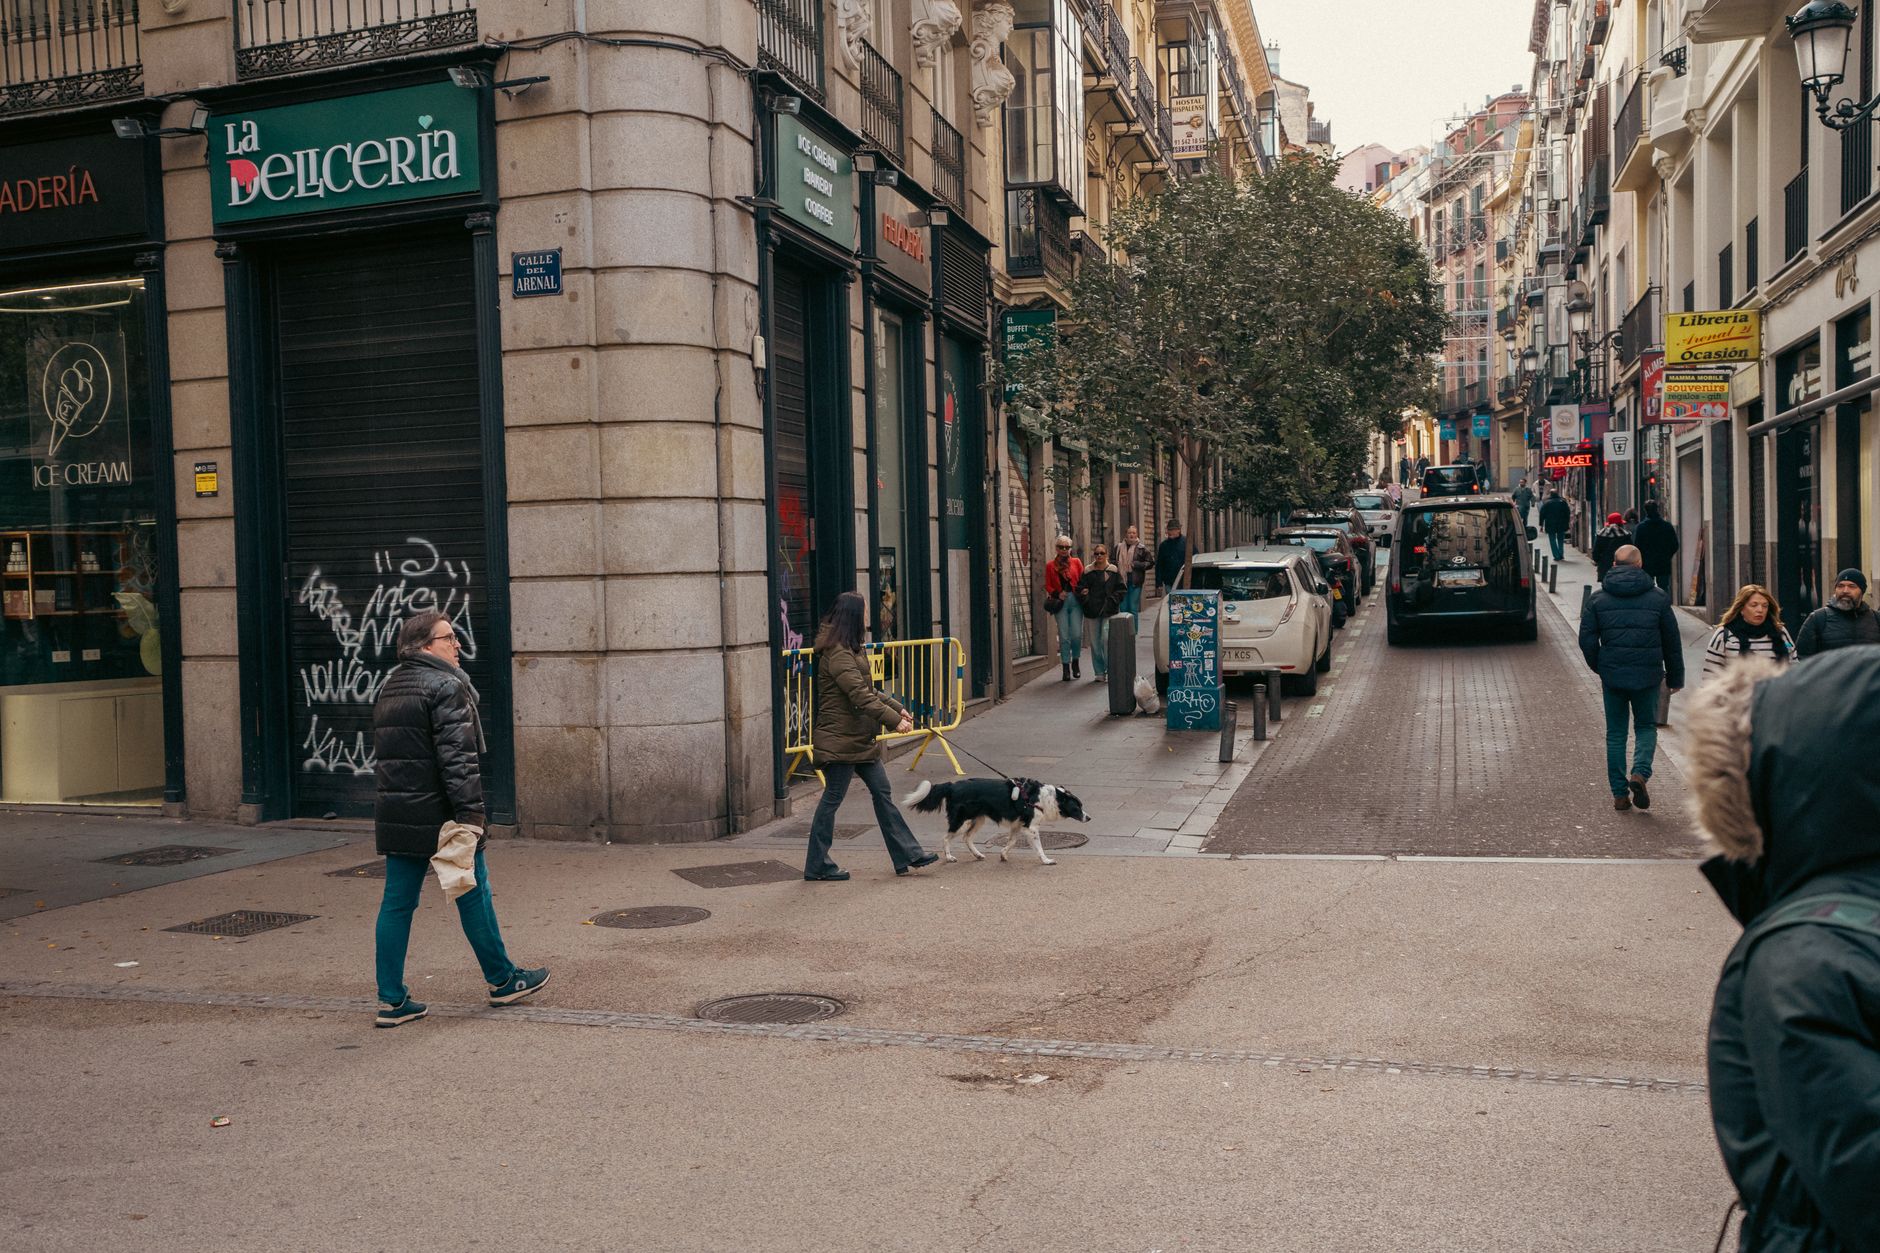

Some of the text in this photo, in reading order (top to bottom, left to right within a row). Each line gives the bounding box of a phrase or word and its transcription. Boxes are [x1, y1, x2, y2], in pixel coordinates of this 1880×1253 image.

[1172, 104, 1205, 113] HISPALENSE
[797, 134, 811, 157] ICE
[803, 167, 833, 198] BAKERY
[804, 198, 834, 227] COFFEE
[519, 254, 553, 266] CALLE
[526, 267, 546, 275] DEL
[516, 275, 558, 292] ARENAL
[1006, 316, 1014, 324] EL
[1680, 312, 1749, 327] Librería
[1007, 325, 1028, 333] BUFFET
[1681, 347, 1749, 361] Ocasión
[1644, 356, 1664, 381] ALIME
[1666, 383, 1726, 392] souvenirs
[1668, 391, 1700, 402] regalos
[1707, 391, 1722, 402] gift
[33, 461, 129, 488] ICE CREAM
[1234, 650, 1251, 659] KCS
